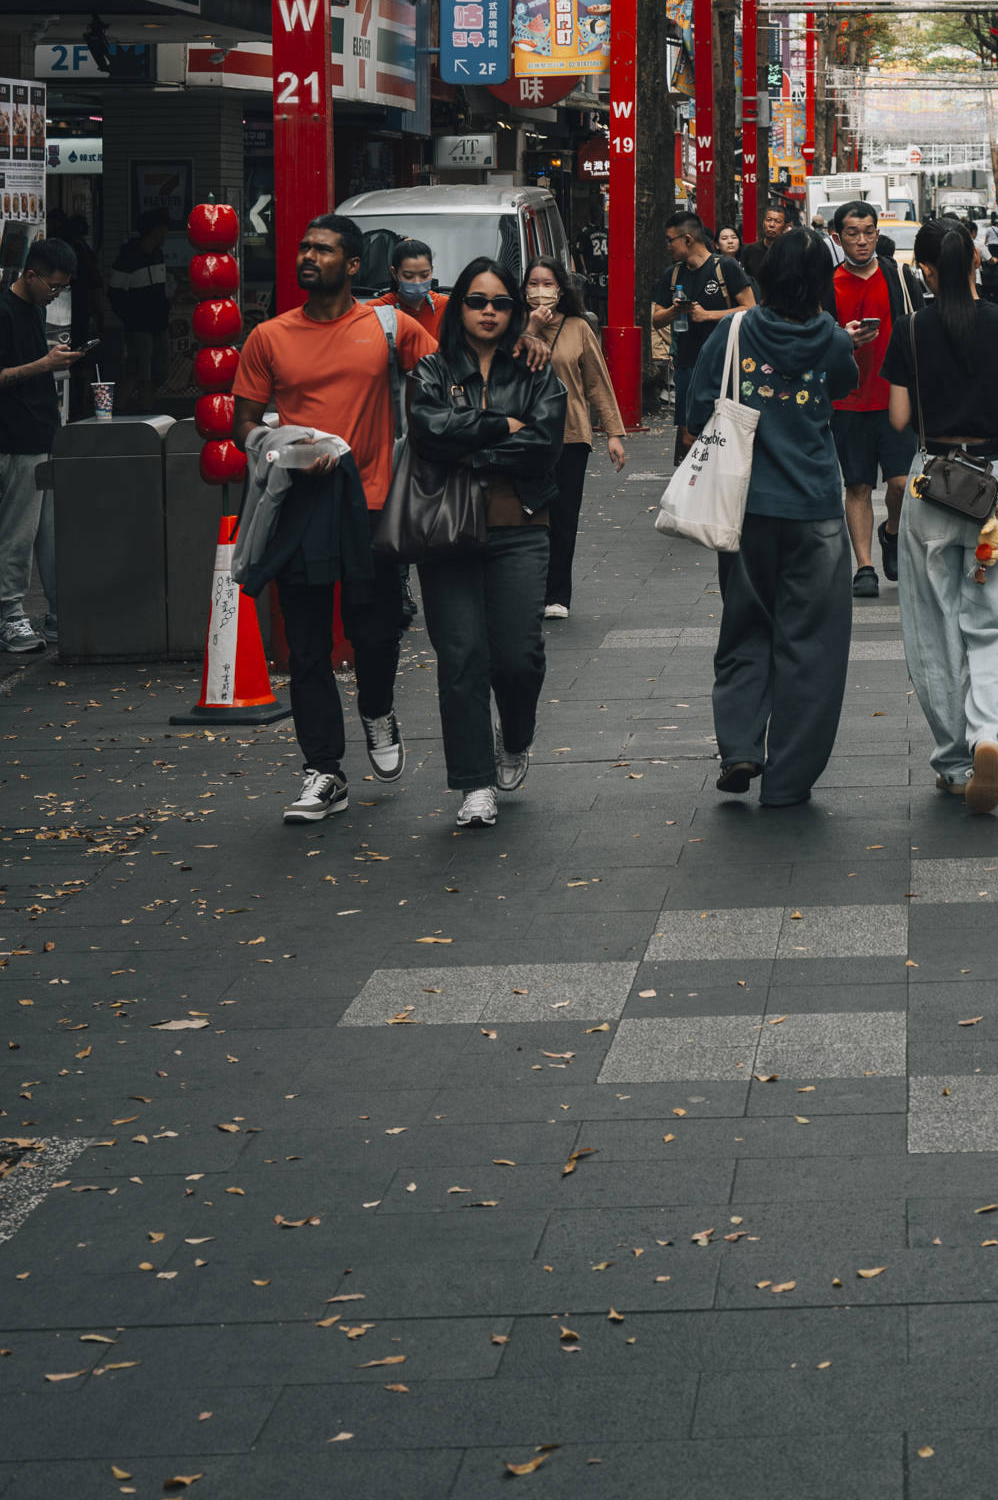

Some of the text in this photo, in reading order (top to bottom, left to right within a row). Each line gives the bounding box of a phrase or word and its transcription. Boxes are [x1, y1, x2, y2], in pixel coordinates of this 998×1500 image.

[278, 0, 319, 31] W
[51, 46, 88, 71] 2F
[479, 63, 496, 75] 2F
[277, 71, 319, 103] 21
[612, 101, 633, 118] W
[448, 139, 479, 155] AT
[612, 136, 634, 153] 19
[697, 136, 711, 148] W
[698, 161, 712, 172] 17
[744, 154, 755, 164] W
[744, 173, 756, 183] 15
[592, 239, 609, 255] 24
